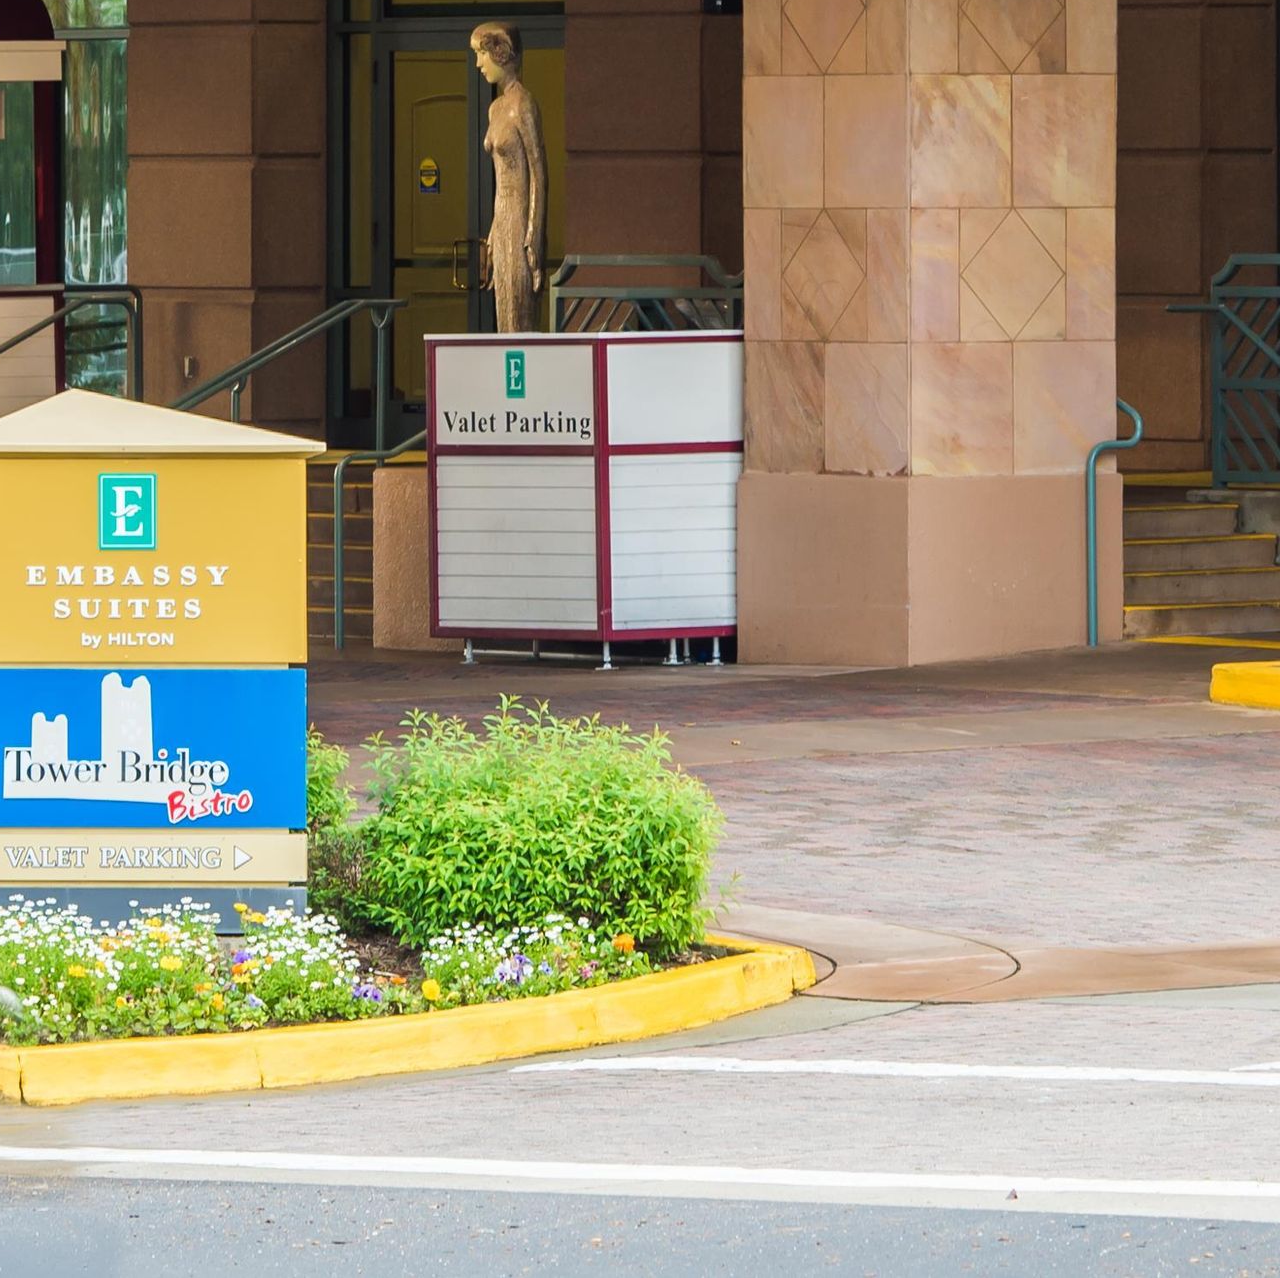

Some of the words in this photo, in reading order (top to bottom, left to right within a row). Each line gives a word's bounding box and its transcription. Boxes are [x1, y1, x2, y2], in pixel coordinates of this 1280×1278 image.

[443, 411, 496, 433] Valet
[505, 411, 591, 440] Parking
[110, 486, 144, 536] E
[25, 565, 229, 586] EMBASSY
[53, 598, 202, 619] SUITES
[81, 633, 102, 648] by
[108, 632, 174, 646] HILTON
[5, 749, 107, 783] Tower
[117, 748, 227, 796] Bridge
[168, 790, 251, 821] Bistro
[4, 846, 89, 868] VALET
[99, 846, 222, 869] PARKING
